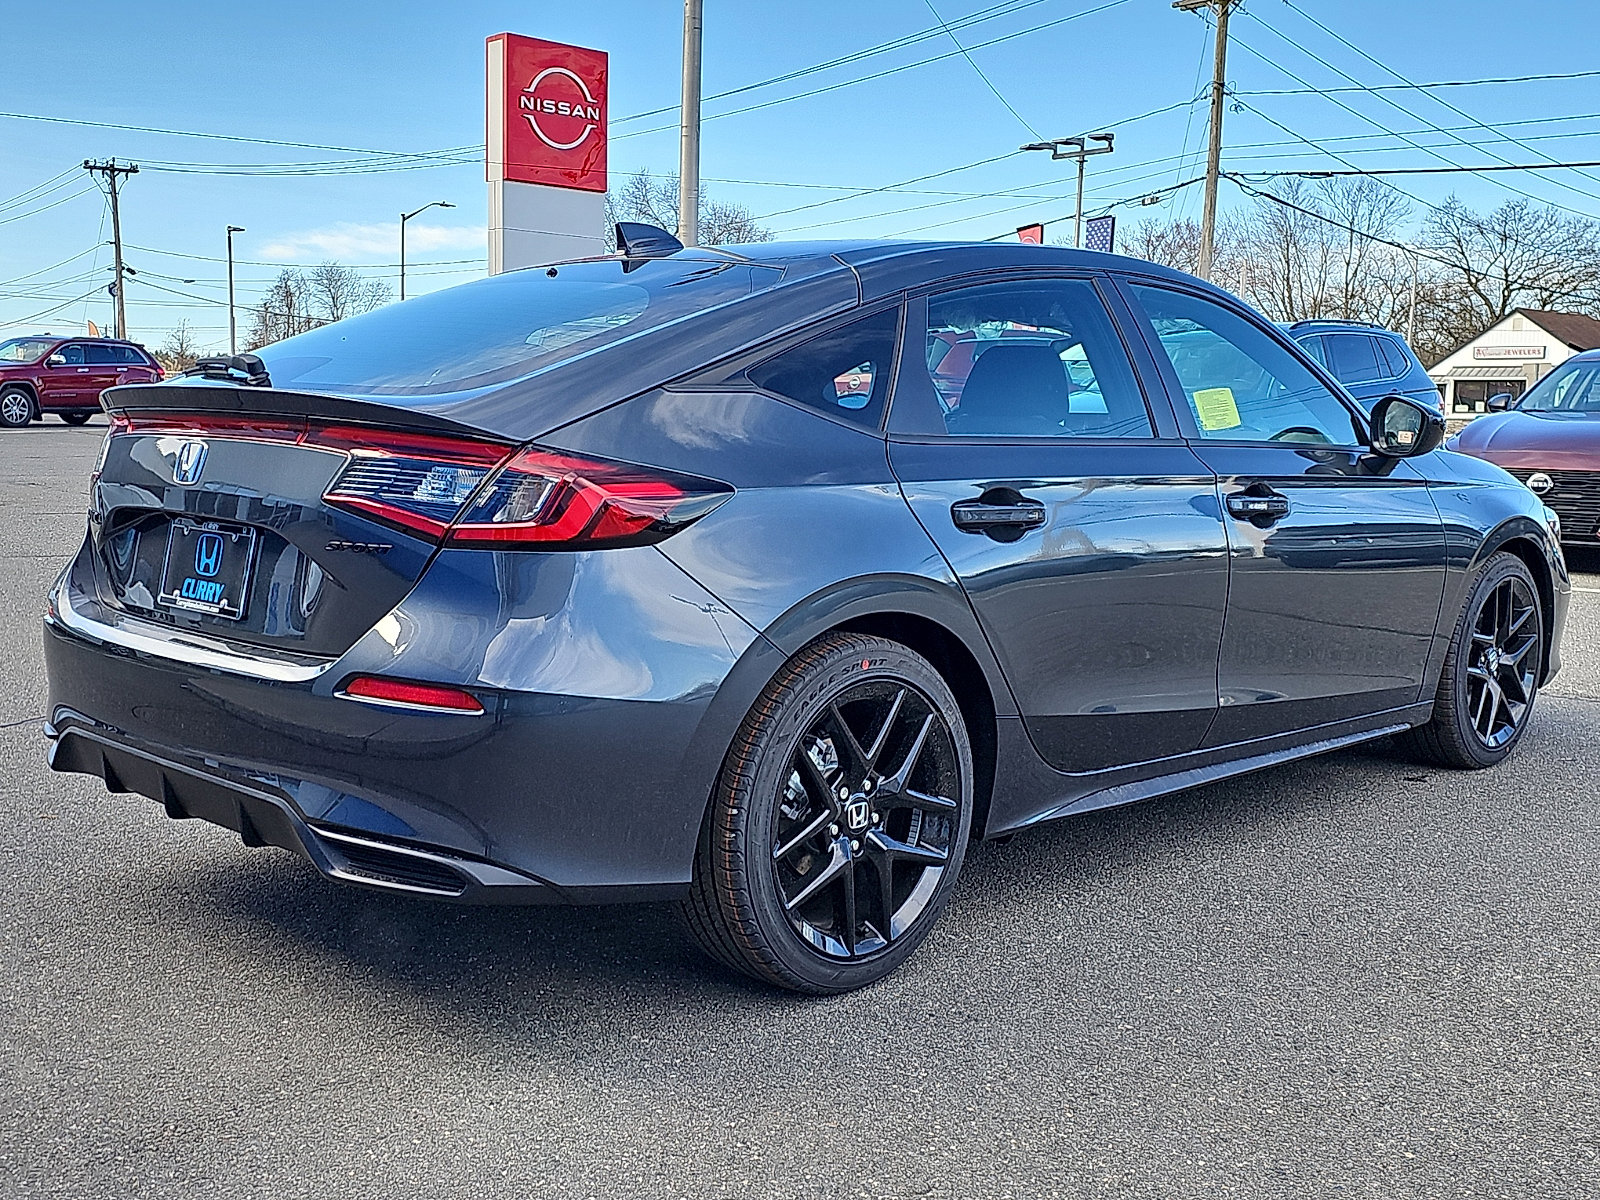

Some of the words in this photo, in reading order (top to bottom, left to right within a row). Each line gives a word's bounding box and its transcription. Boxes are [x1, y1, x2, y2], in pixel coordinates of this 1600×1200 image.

[519, 95, 600, 120] NISSAN
[325, 541, 393, 553] SPORT
[181, 578, 225, 603] CURRY
